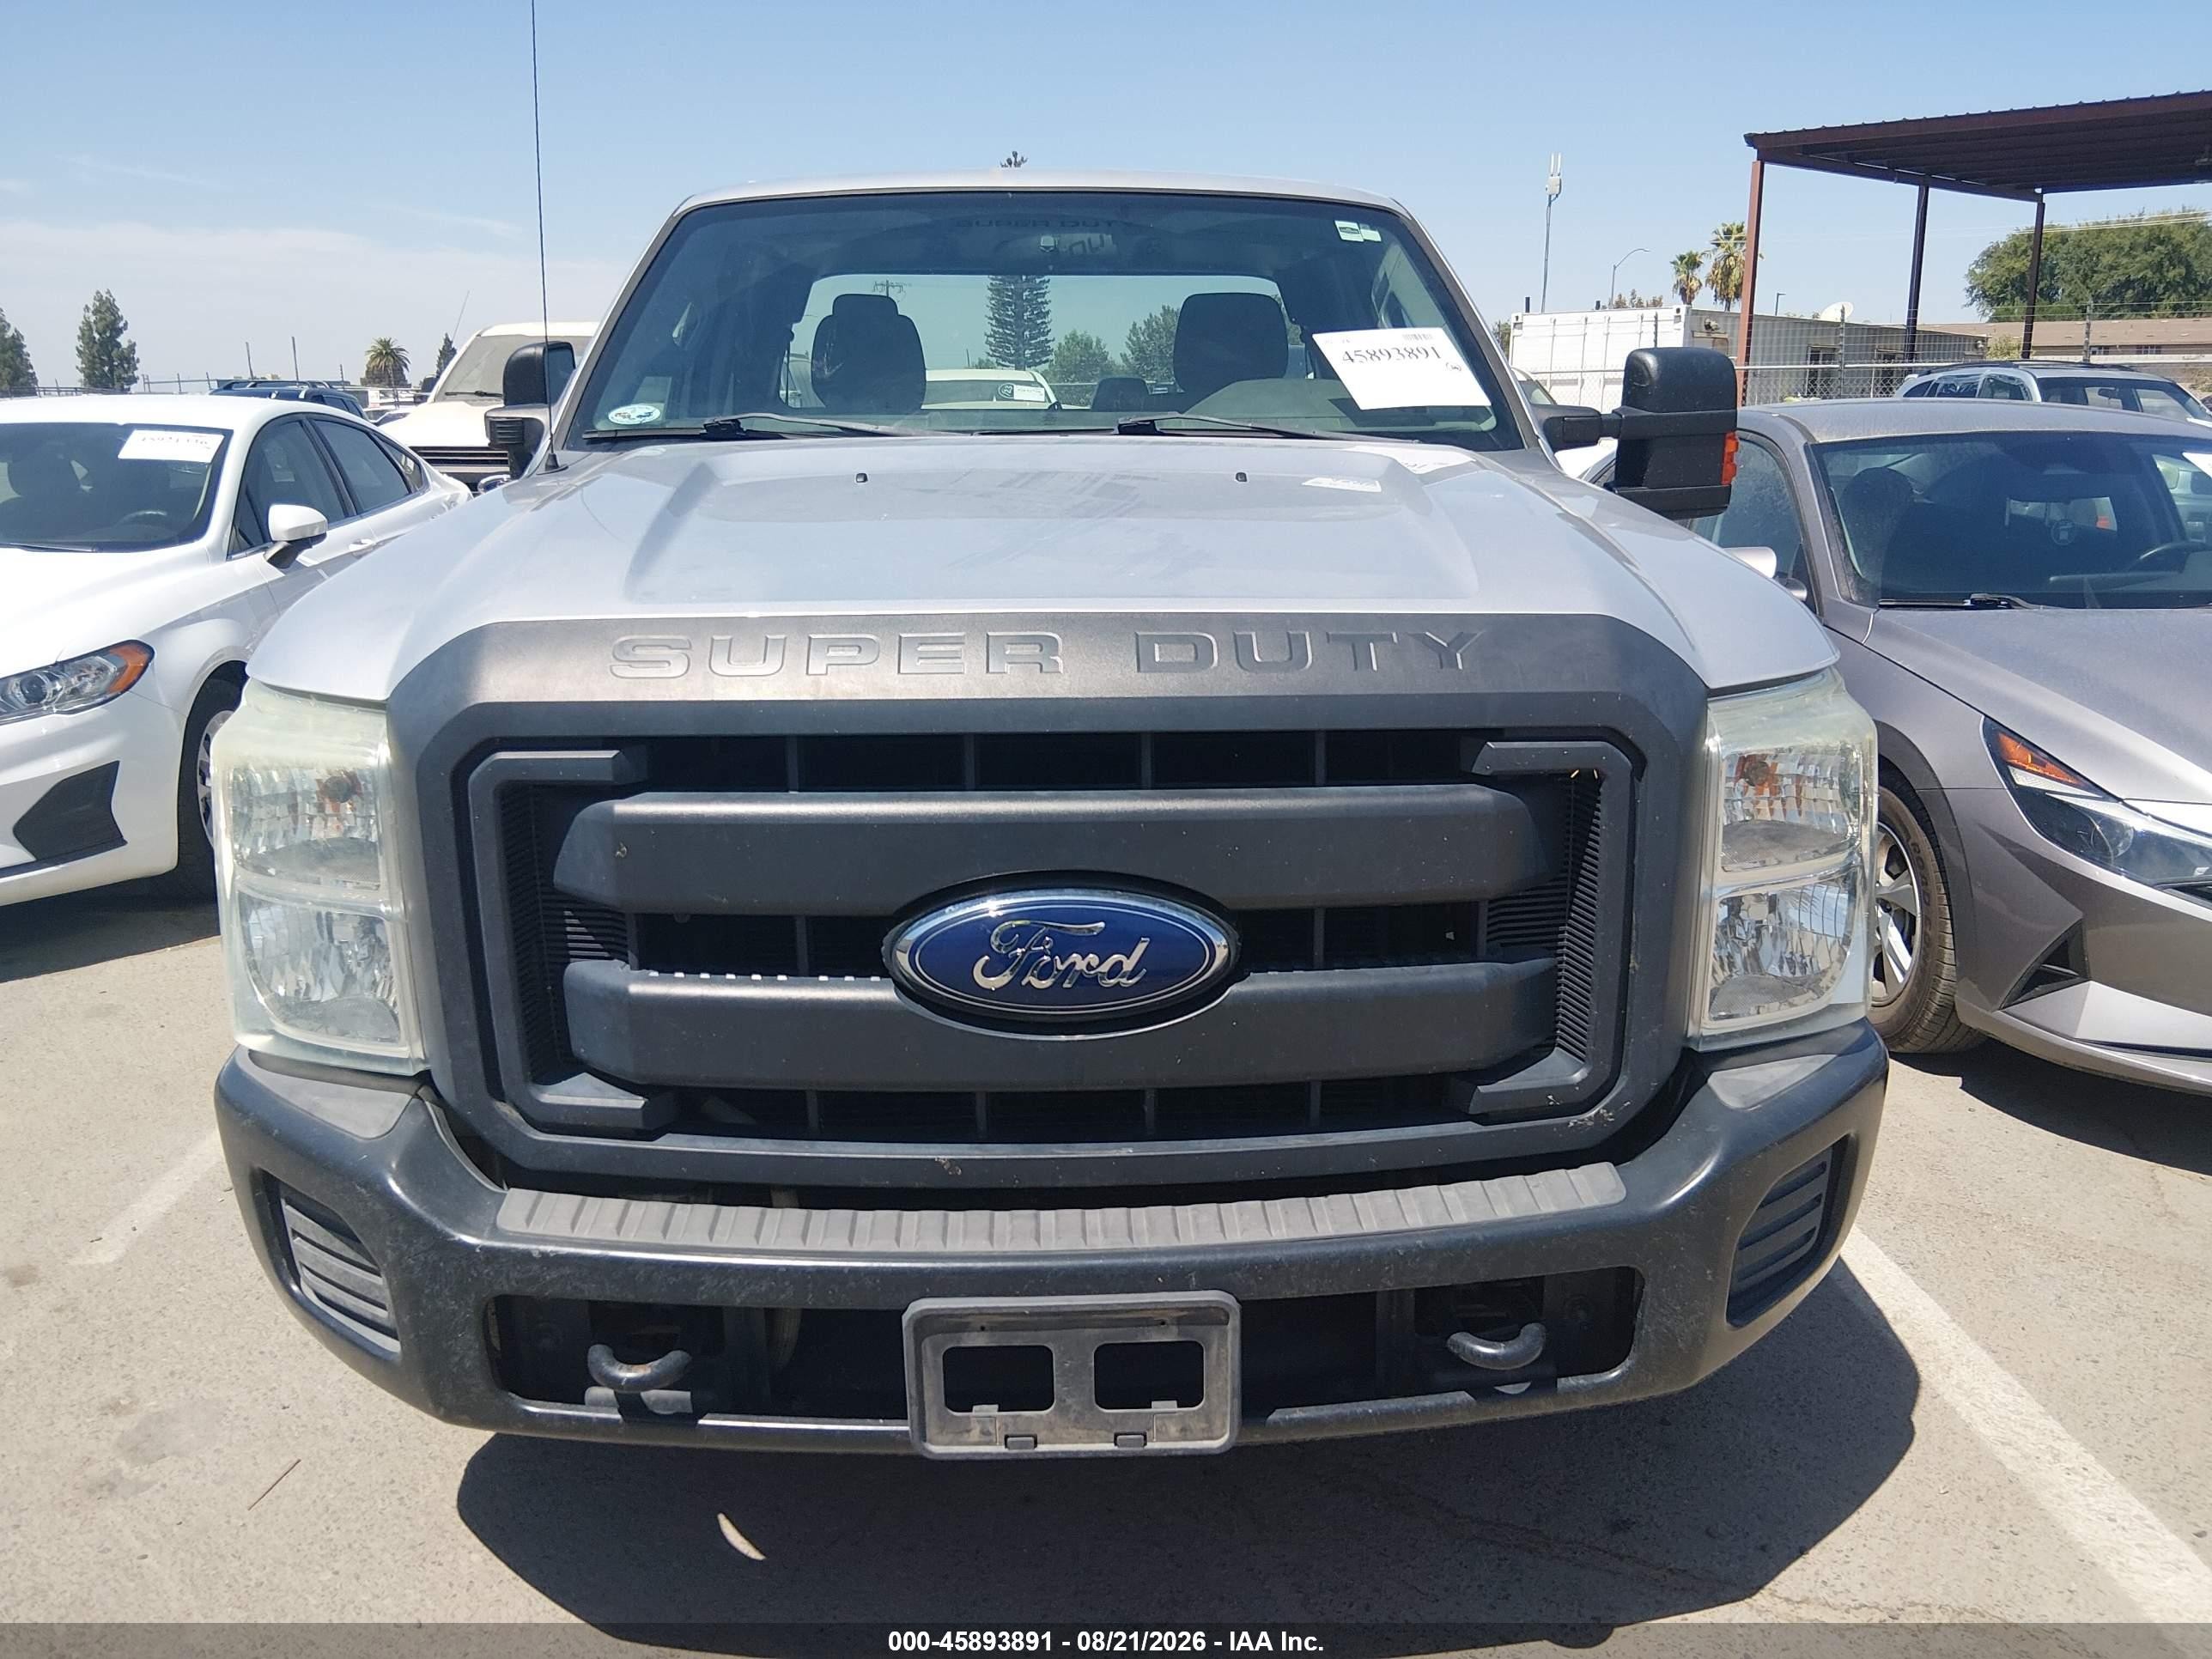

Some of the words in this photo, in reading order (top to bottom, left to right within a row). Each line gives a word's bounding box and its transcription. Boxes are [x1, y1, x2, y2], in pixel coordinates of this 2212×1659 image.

[1342, 346, 1442, 364] 45893891
[610, 633, 1064, 679] SUPER
[1135, 630, 1486, 673] DUTY
[972, 919, 1152, 990] Ford
